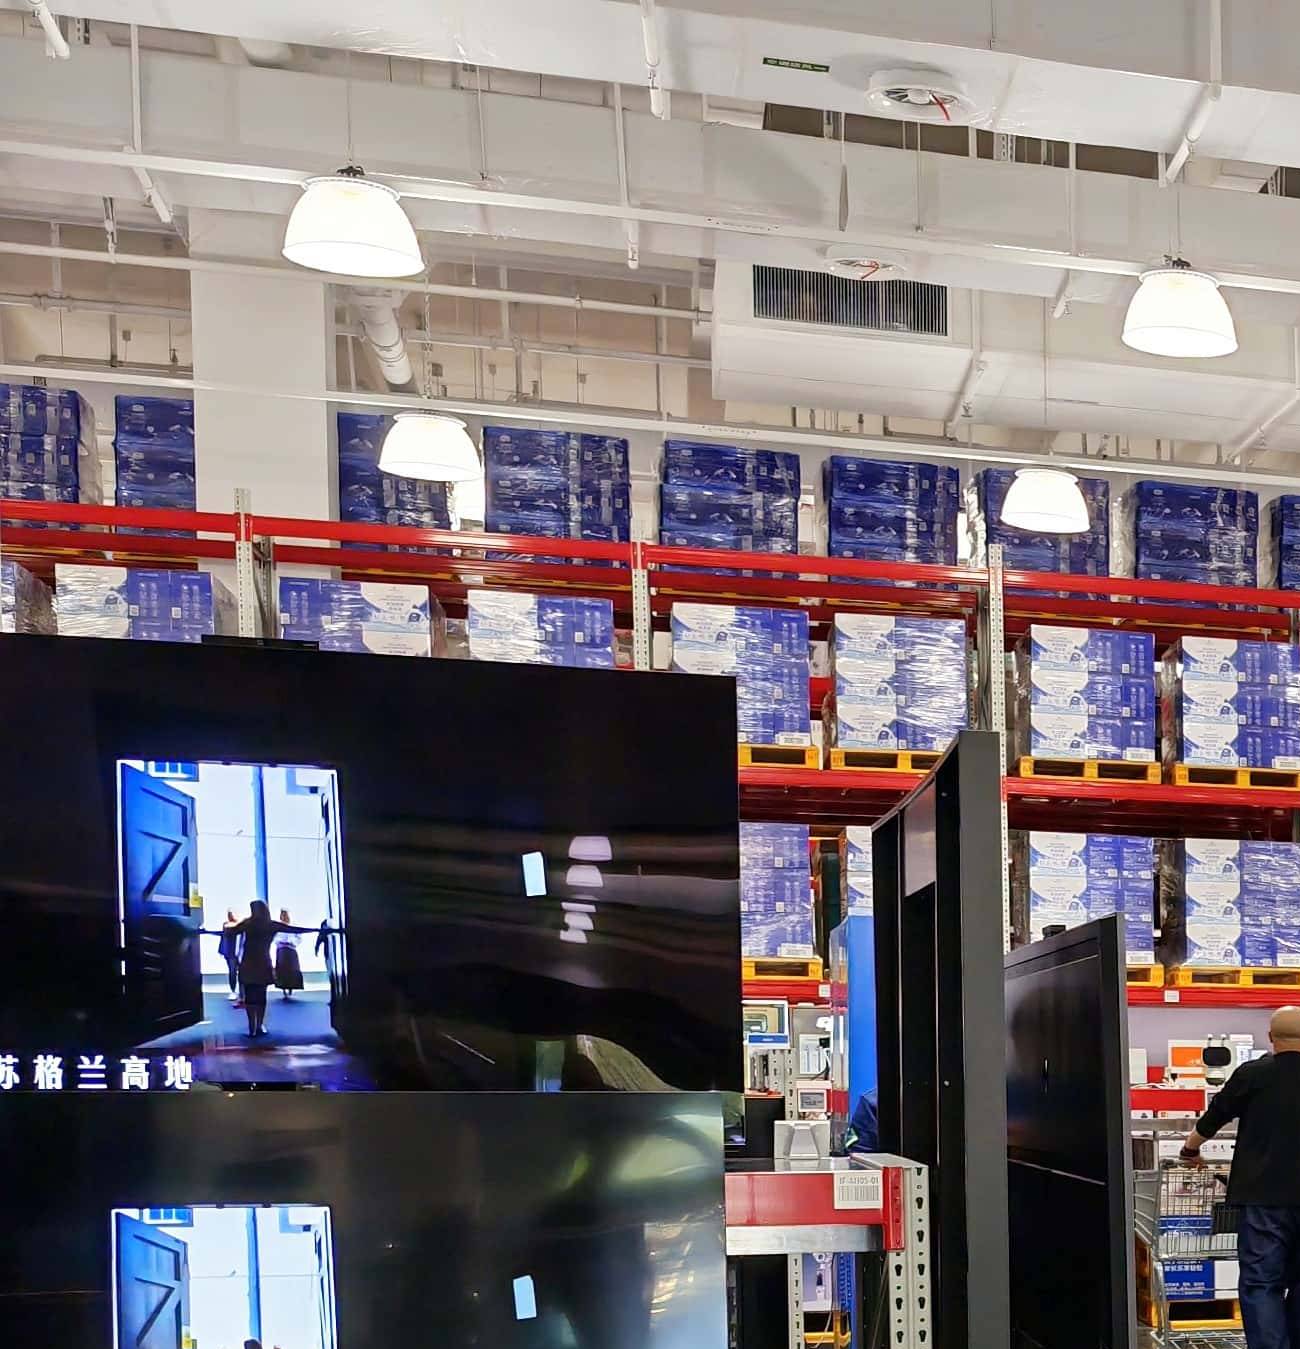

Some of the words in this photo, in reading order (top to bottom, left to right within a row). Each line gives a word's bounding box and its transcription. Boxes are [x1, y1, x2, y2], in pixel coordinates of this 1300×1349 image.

[0, 1055, 193, 1091] 苏格兰高地
